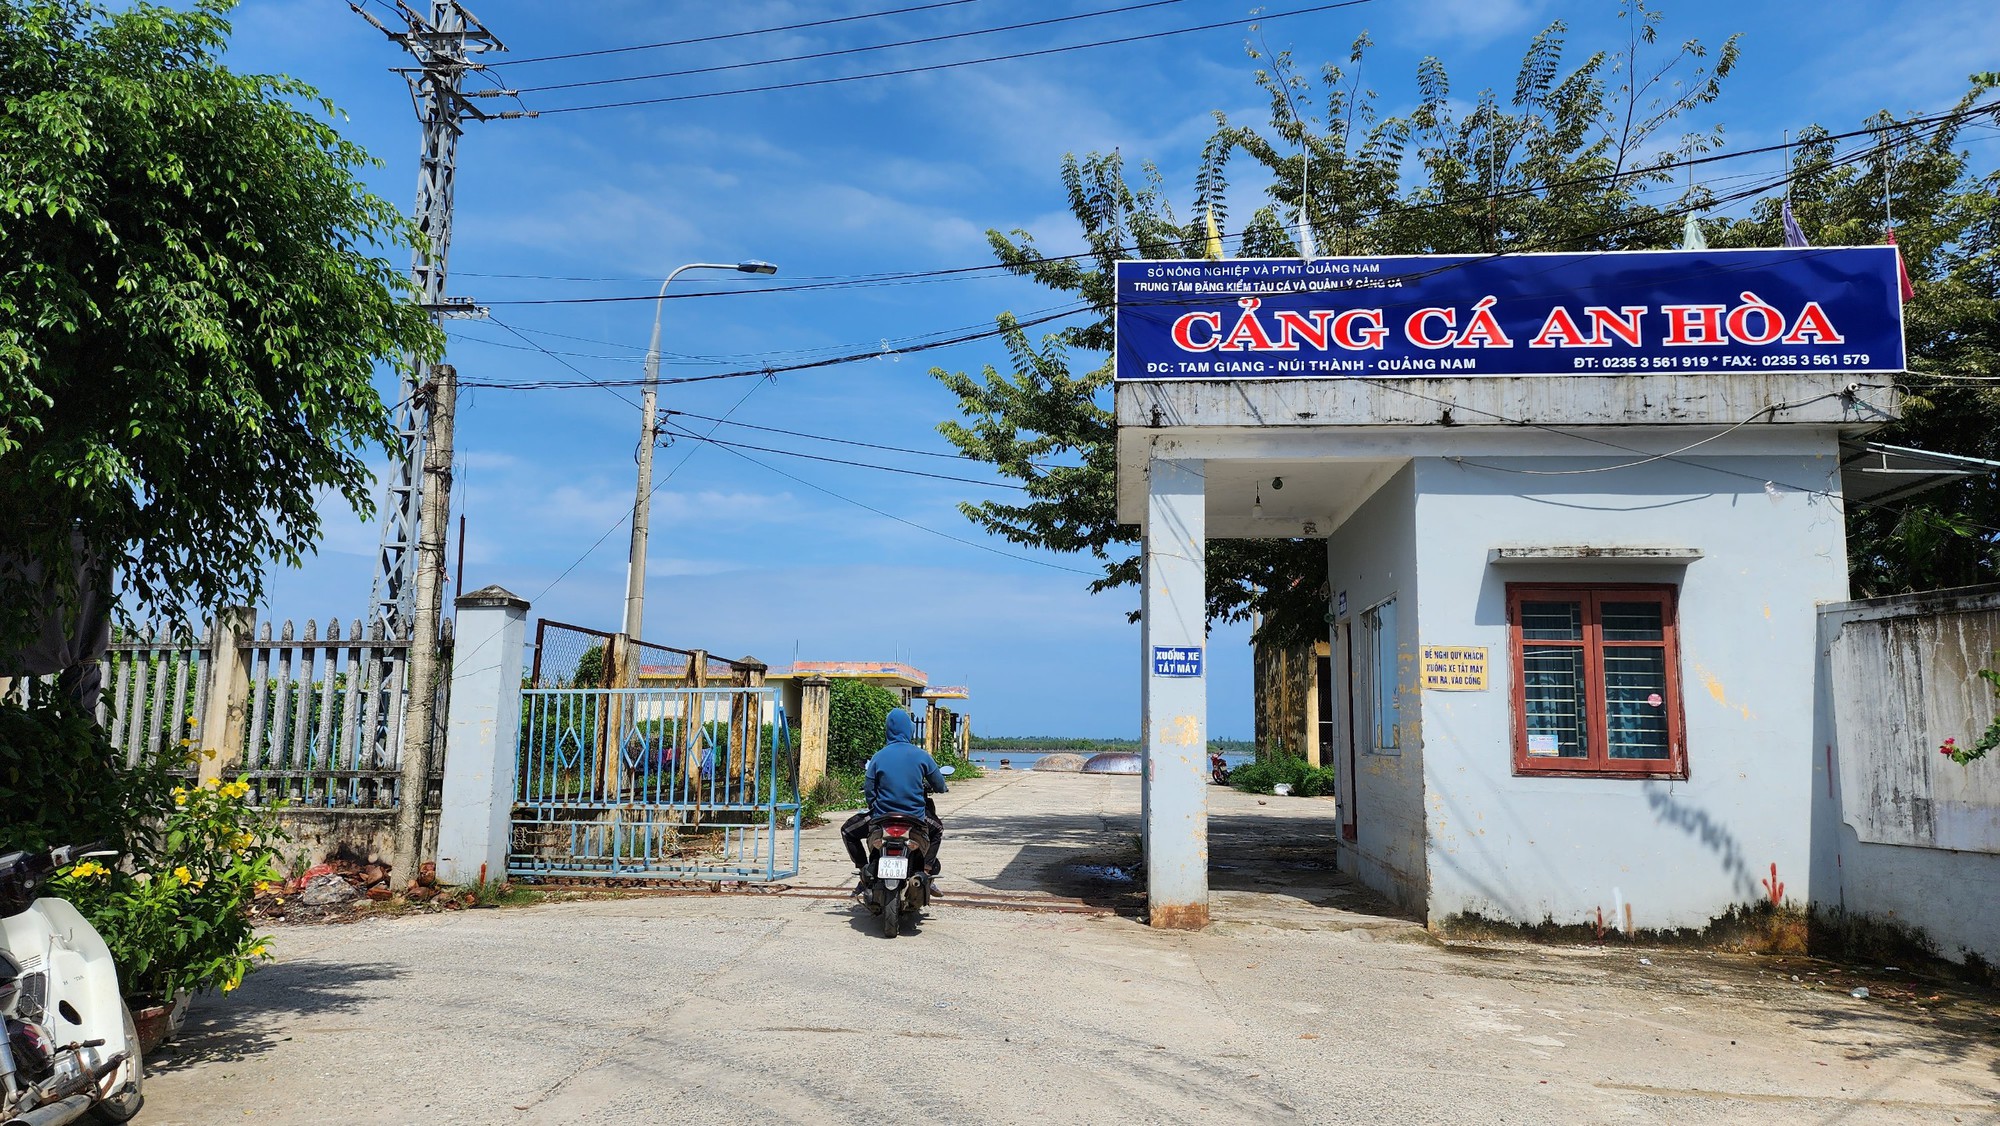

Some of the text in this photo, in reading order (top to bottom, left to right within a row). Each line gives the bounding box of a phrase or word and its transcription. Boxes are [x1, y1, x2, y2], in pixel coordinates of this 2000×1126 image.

[1167, 266, 1200, 277] NÔNG
[1204, 265, 1250, 277] NGHIỆP
[1253, 264, 1269, 276] VÀ
[1272, 265, 1303, 275] PTNT
[1306, 262, 1350, 275] QUẢNG
[1353, 263, 1380, 273] NAM
[1134, 282, 1169, 292] TRUNG
[1172, 280, 1193, 292] TÂM
[1195, 281, 1224, 292] ĐĂNG
[1227, 279, 1252, 292] KIỂM
[1253, 280, 1274, 291] TÀU
[1276, 279, 1291, 291] CÁ
[1293, 279, 1307, 291] VÀ
[1309, 278, 1338, 291] QUẢN
[1171, 291, 1845, 352] CẢNG CÁ AN HÒA
[1147, 362, 1174, 373] ĐC:
[1178, 362, 1210, 373] TAM
[1214, 361, 1265, 372] GIANG
[1278, 358, 1305, 371] NÚI
[1309, 358, 1364, 371] THÀNH
[1377, 356, 1436, 370] QUẢNG
[1440, 358, 1476, 369] NAM
[1574, 354, 1870, 368] ĐT: 0235 3 561 919 FAX: 0235 3 561 579
[1156, 648, 1200, 661] XUỐNG XE
[1177, 662, 1198, 674] MÁY
[1448, 664, 1456, 673] XE
[1428, 675, 1439, 684] KHI
